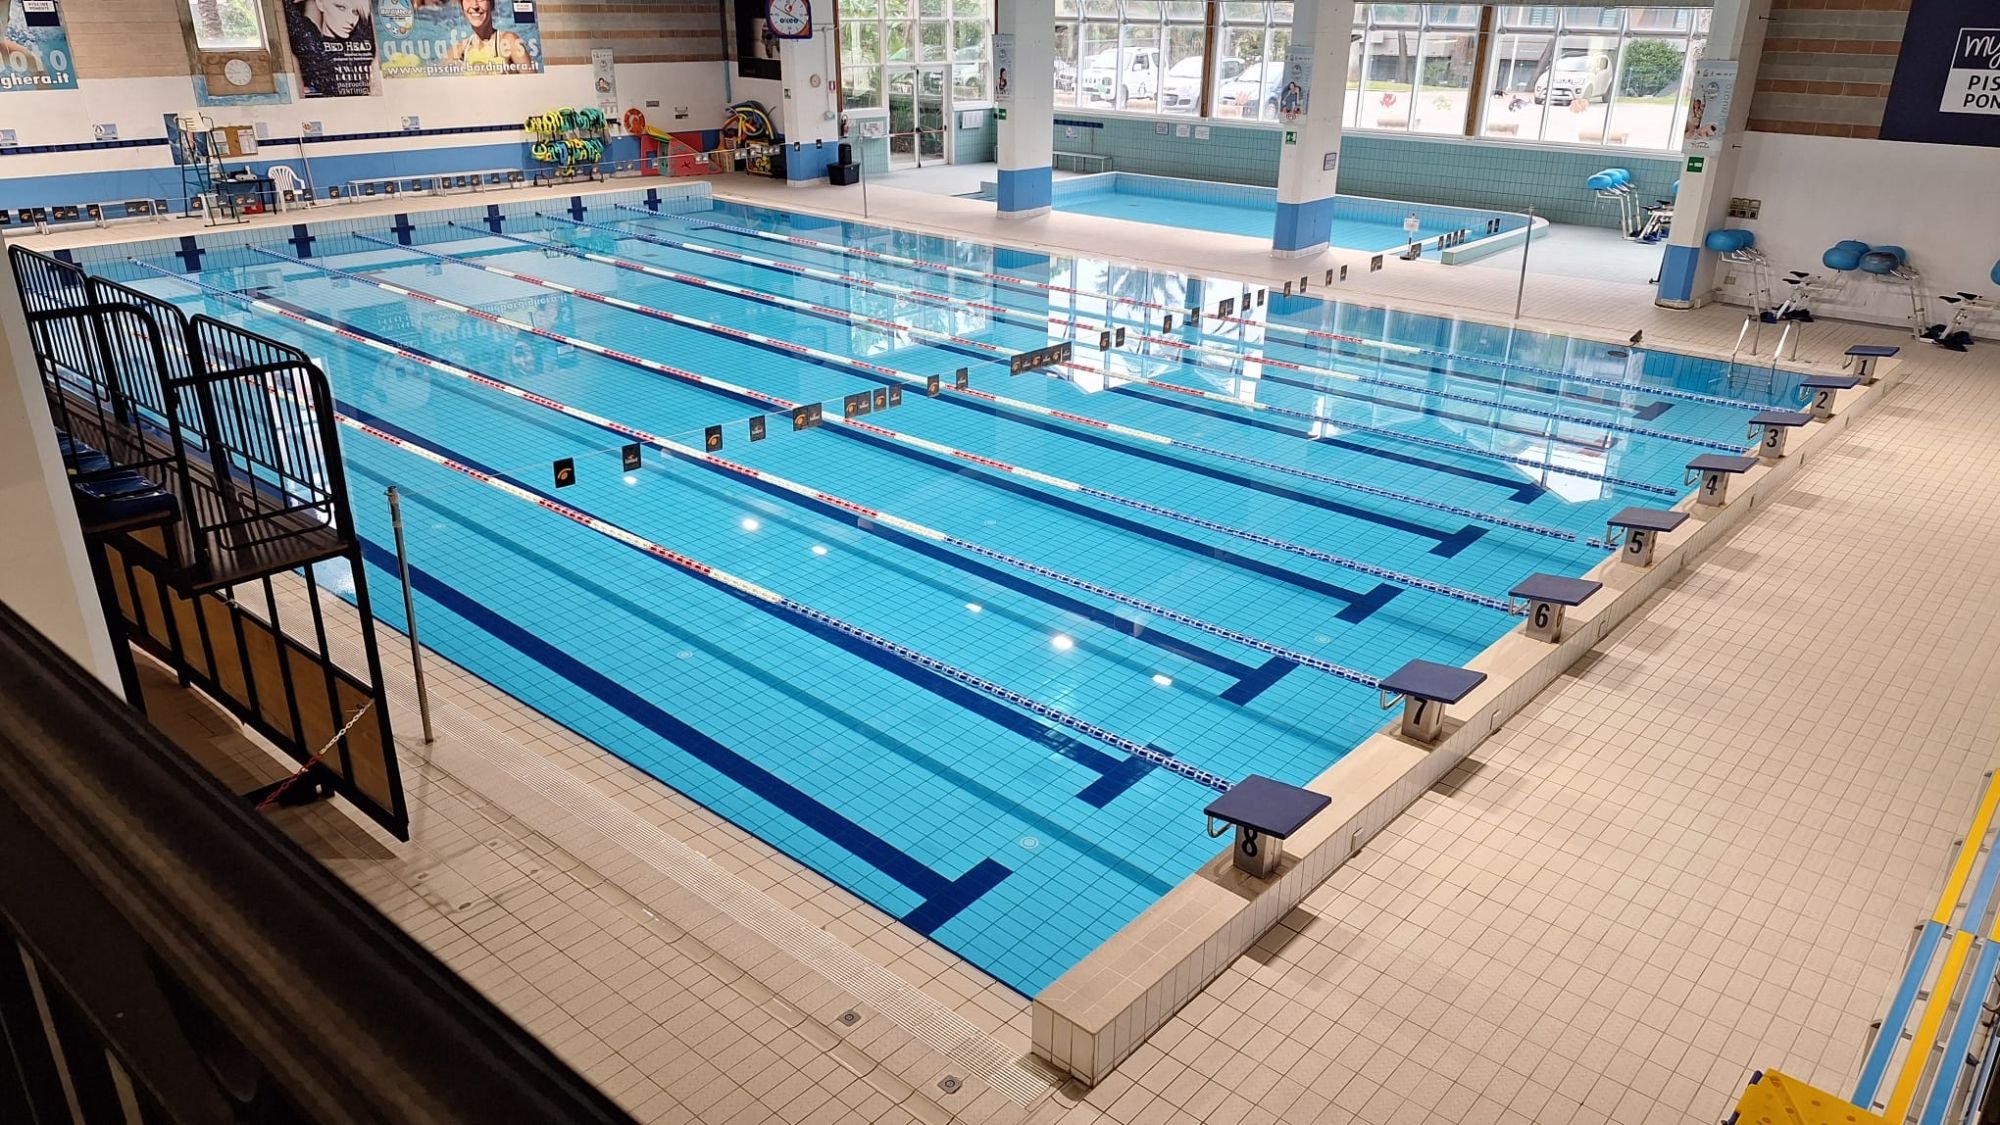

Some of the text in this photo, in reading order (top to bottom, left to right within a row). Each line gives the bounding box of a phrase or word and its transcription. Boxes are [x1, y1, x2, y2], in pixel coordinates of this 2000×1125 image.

[323, 41, 372, 52] BED HEAD
[387, 61, 539, 75] www.piscinebordighera.it
[1858, 360, 1867, 376] 1
[1815, 391, 1828, 409] 2
[1766, 428, 1778, 448] 3
[1706, 474, 1718, 495] 4
[1629, 531, 1645, 554] 5
[1534, 603, 1550, 629] 6
[1412, 696, 1428, 725] 7
[1241, 826, 1258, 858] 8
